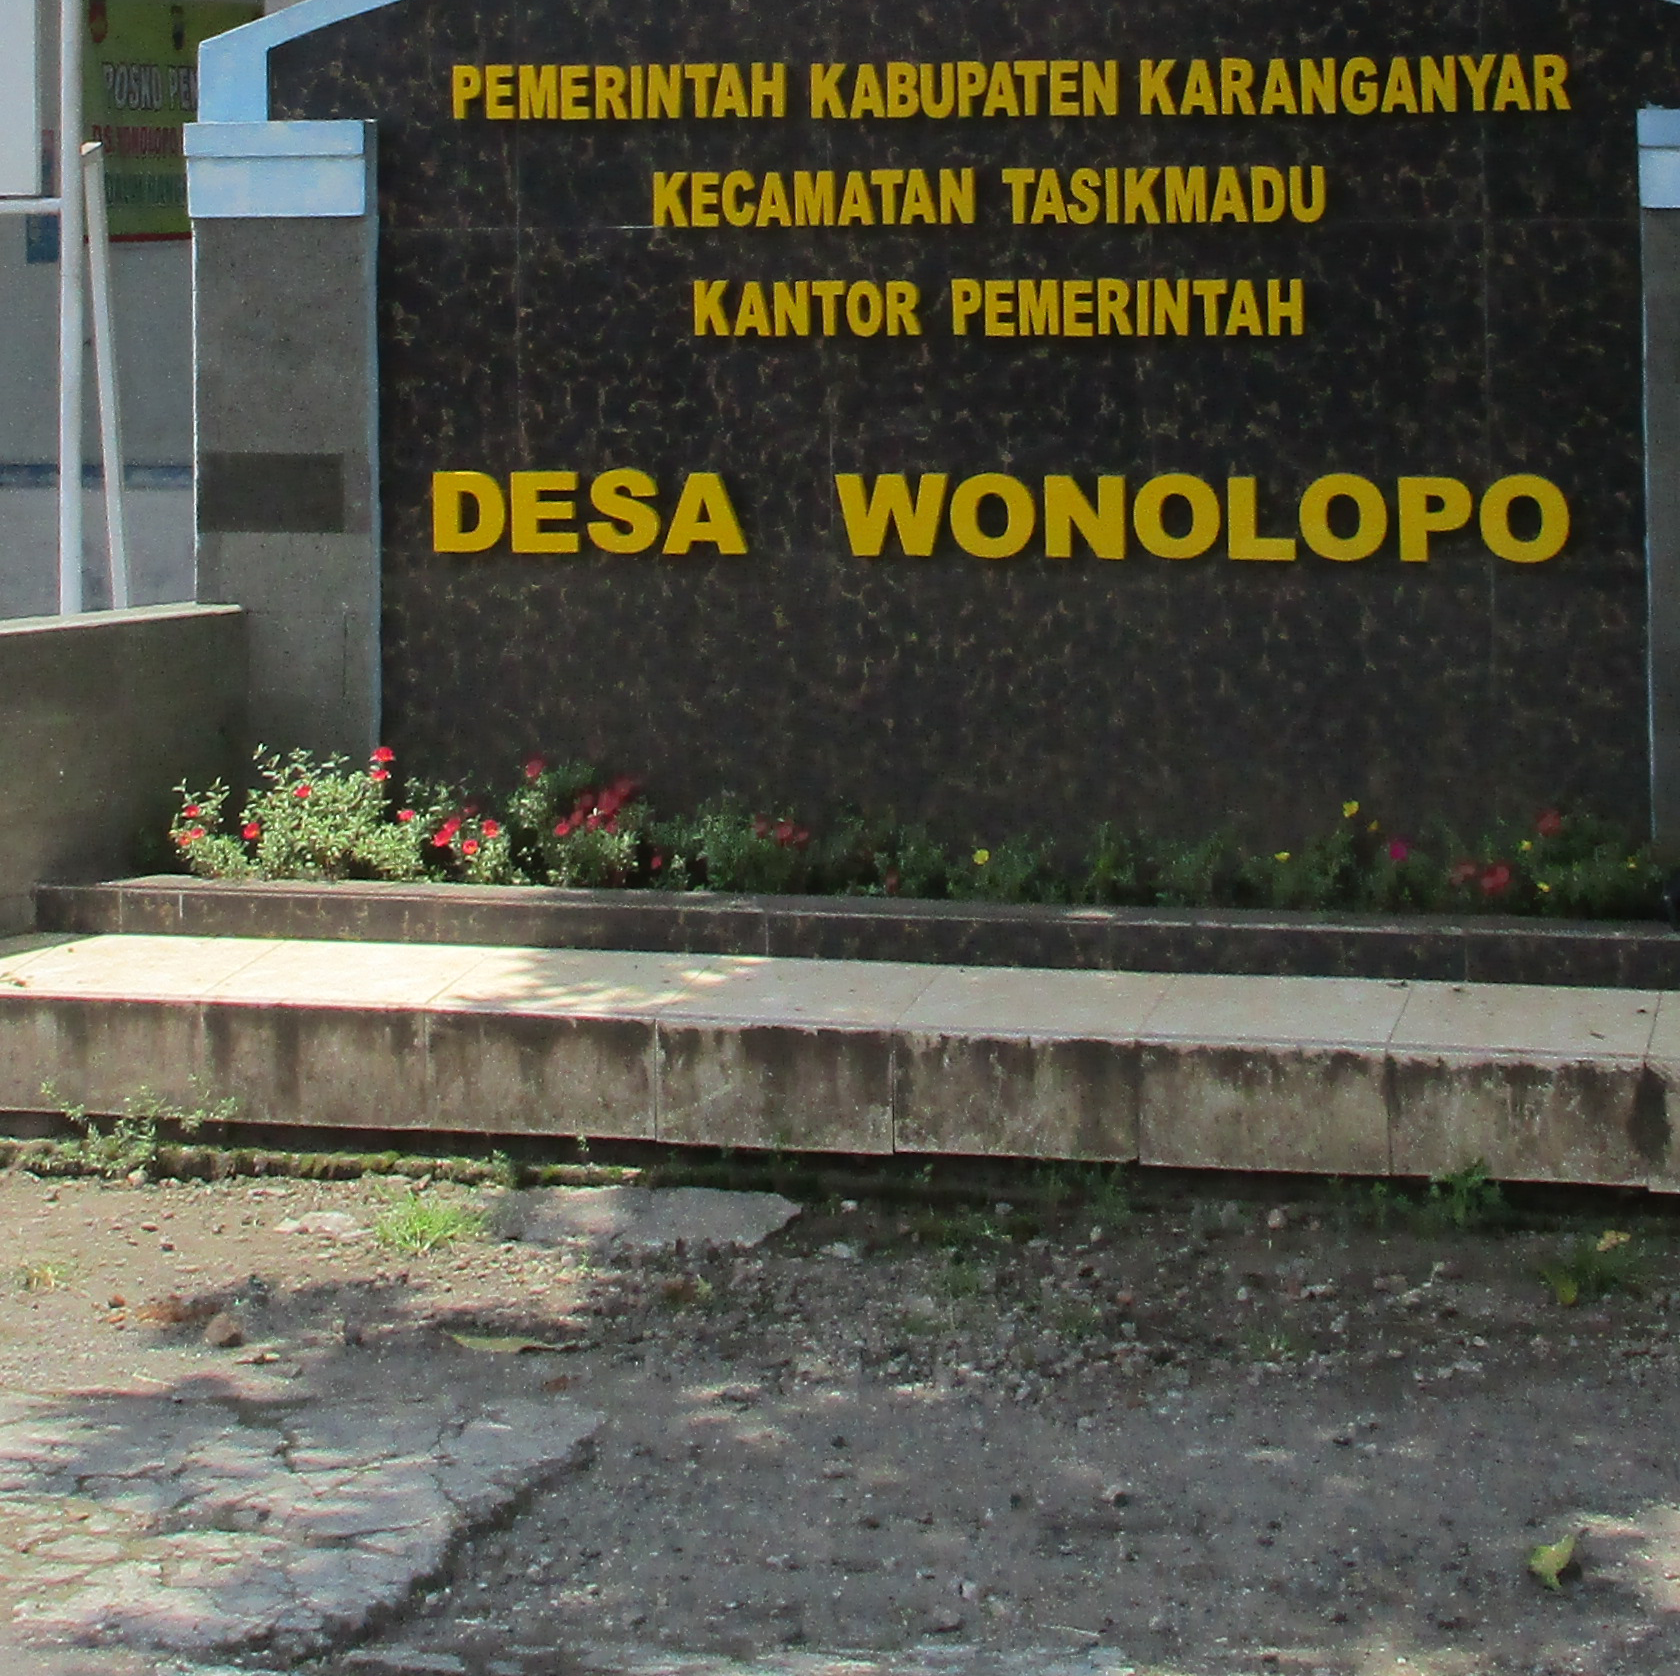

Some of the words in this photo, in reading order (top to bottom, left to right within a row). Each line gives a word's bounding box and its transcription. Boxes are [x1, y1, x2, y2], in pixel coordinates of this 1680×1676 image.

[451, 62, 788, 121] PEMERINTAH
[809, 59, 1120, 120] KABUPATEN
[1138, 53, 1572, 116] KARANGANYAR
[651, 167, 977, 229] KECAMATAN
[1001, 165, 1327, 225] TASIKMADU
[692, 279, 922, 338] KANTOR
[950, 277, 1305, 338] PEMERINTAH
[430, 467, 748, 556] DESA
[834, 472, 1571, 564] WONOLOPO
